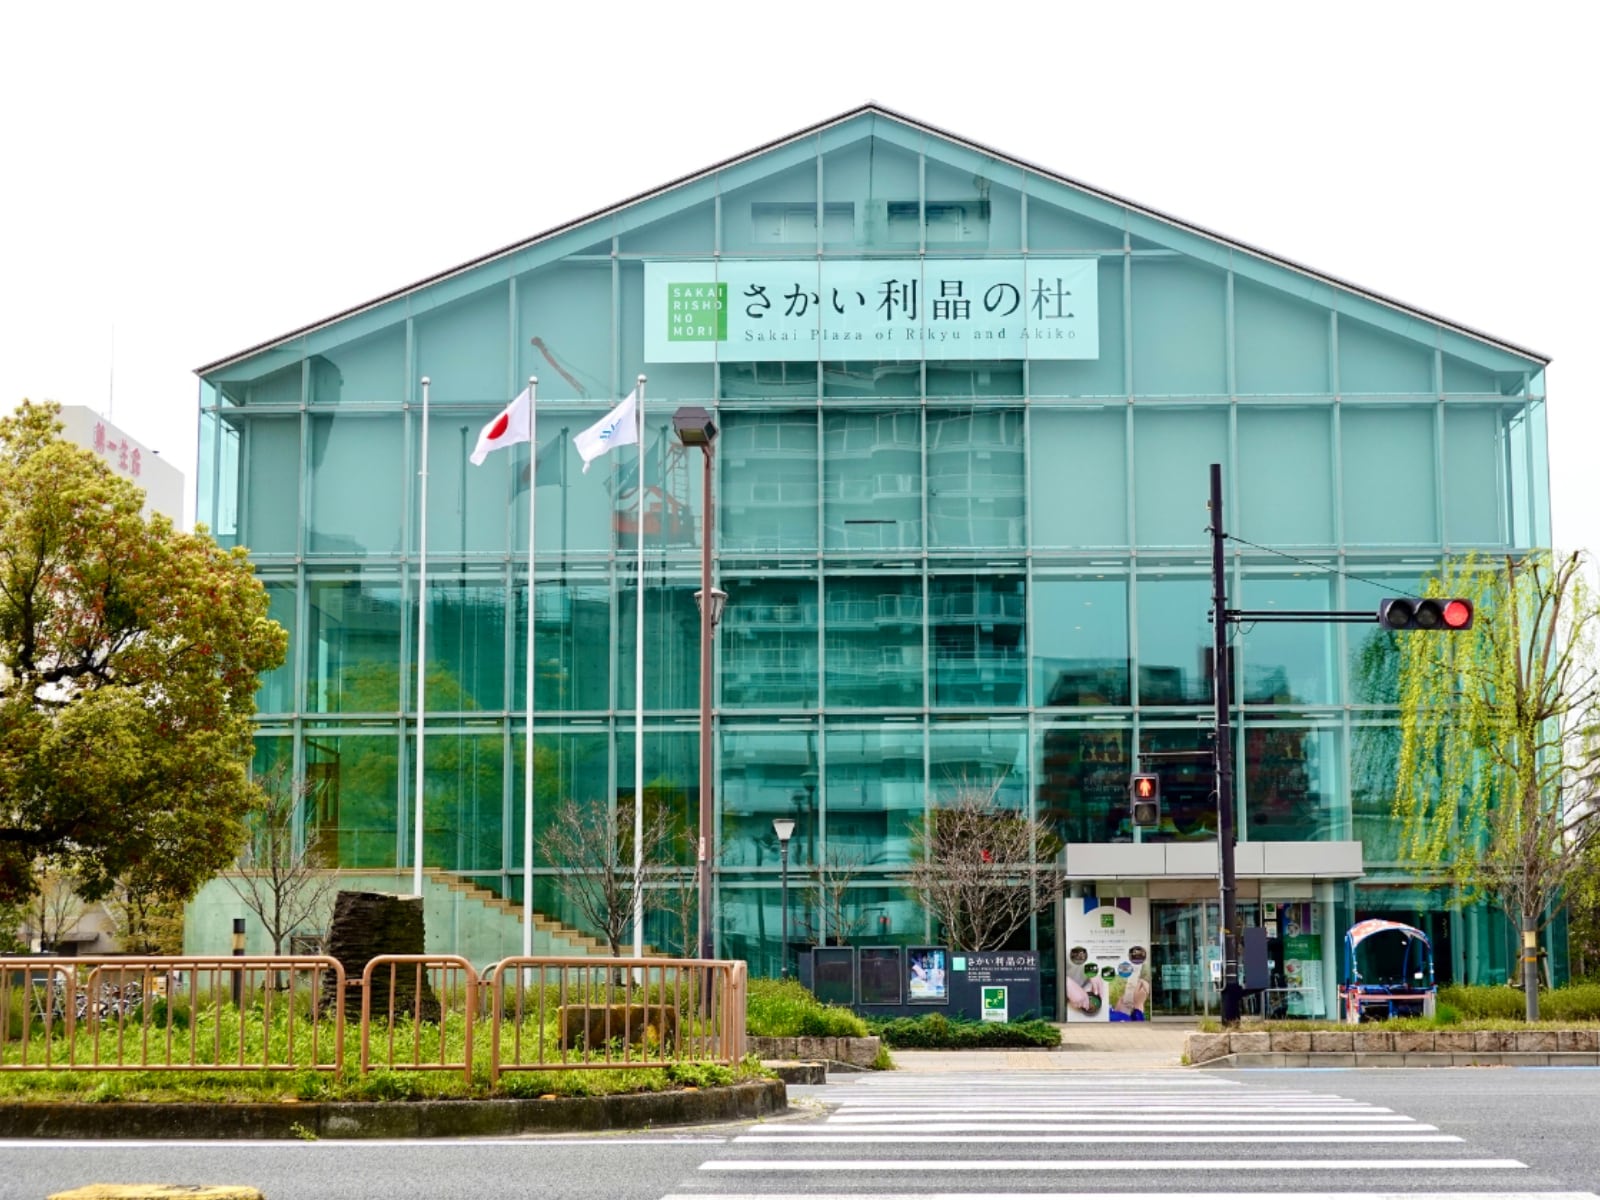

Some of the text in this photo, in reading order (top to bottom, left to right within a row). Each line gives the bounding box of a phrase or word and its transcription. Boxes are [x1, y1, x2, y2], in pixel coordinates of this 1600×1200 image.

[673, 287, 722, 298] SAKAI
[743, 277, 1075, 320] さかい利晶の杜
[673, 300, 722, 310] RISHO
[673, 313, 693, 323] NO
[673, 326, 713, 336] MORI
[744, 327, 1076, 342] Sakai Plaza of Rikyu and Akiko
